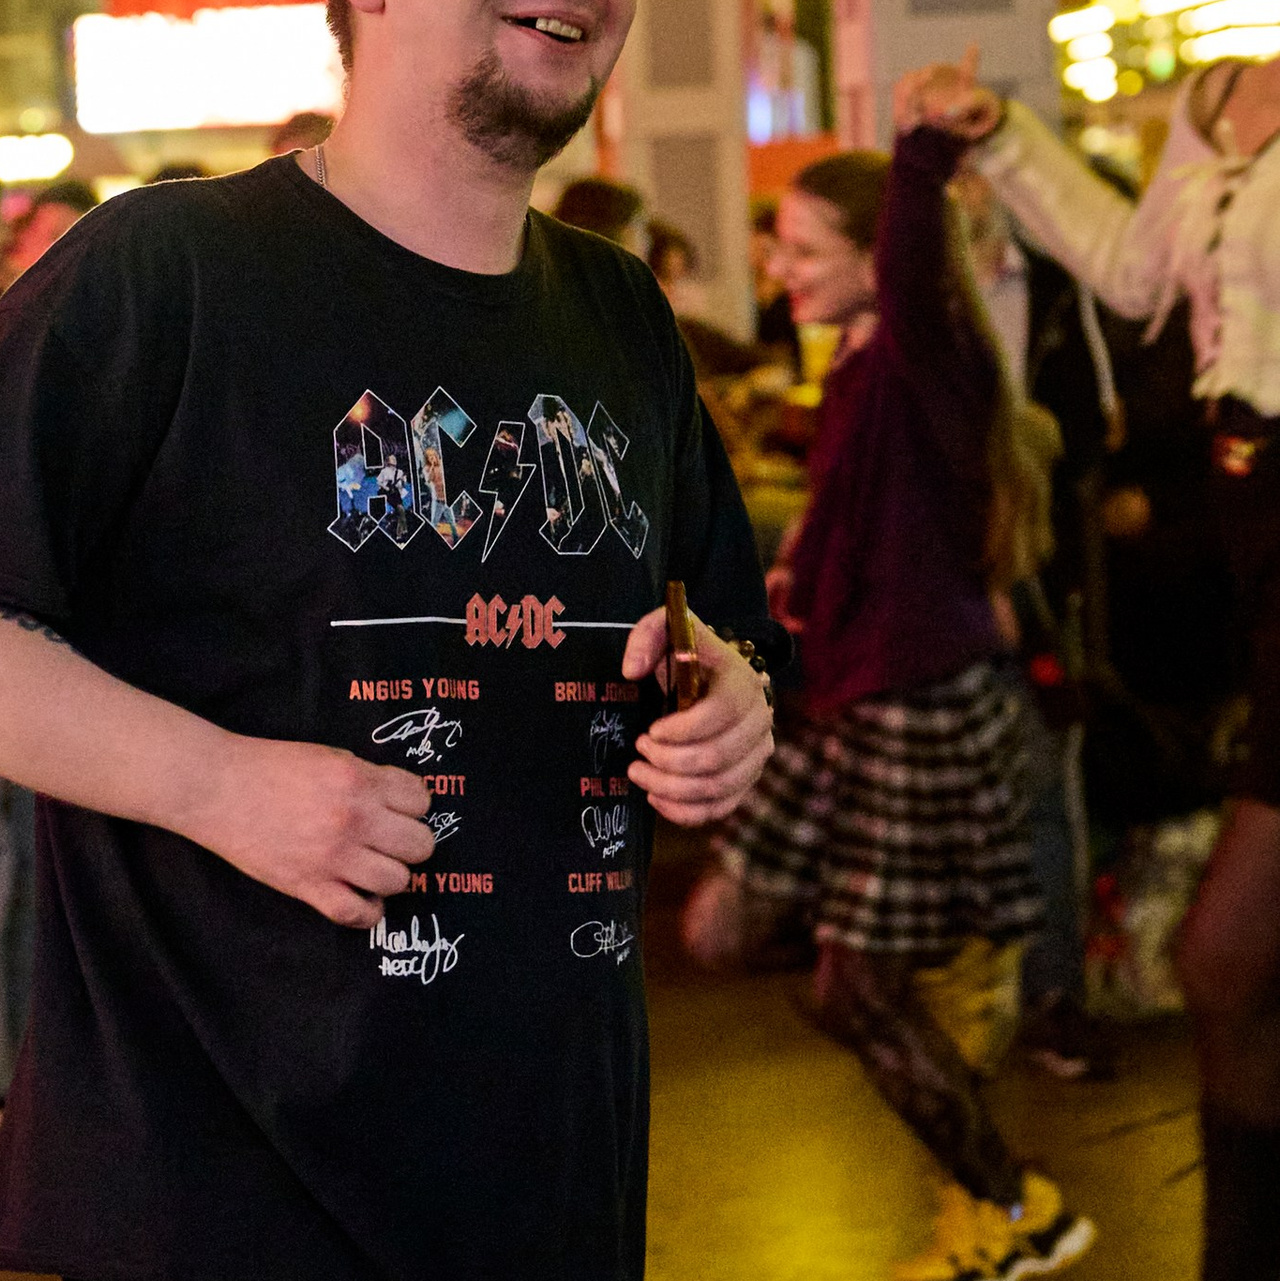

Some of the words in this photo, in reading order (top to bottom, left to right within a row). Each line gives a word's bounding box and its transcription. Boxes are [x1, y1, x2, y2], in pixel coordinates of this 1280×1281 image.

[349, 679, 413, 701] ANGUS
[422, 677, 480, 700] YOUNG
[423, 775, 466, 796] COTT
[435, 873, 493, 894] YOUNG
[568, 873, 602, 893] CLIFF
